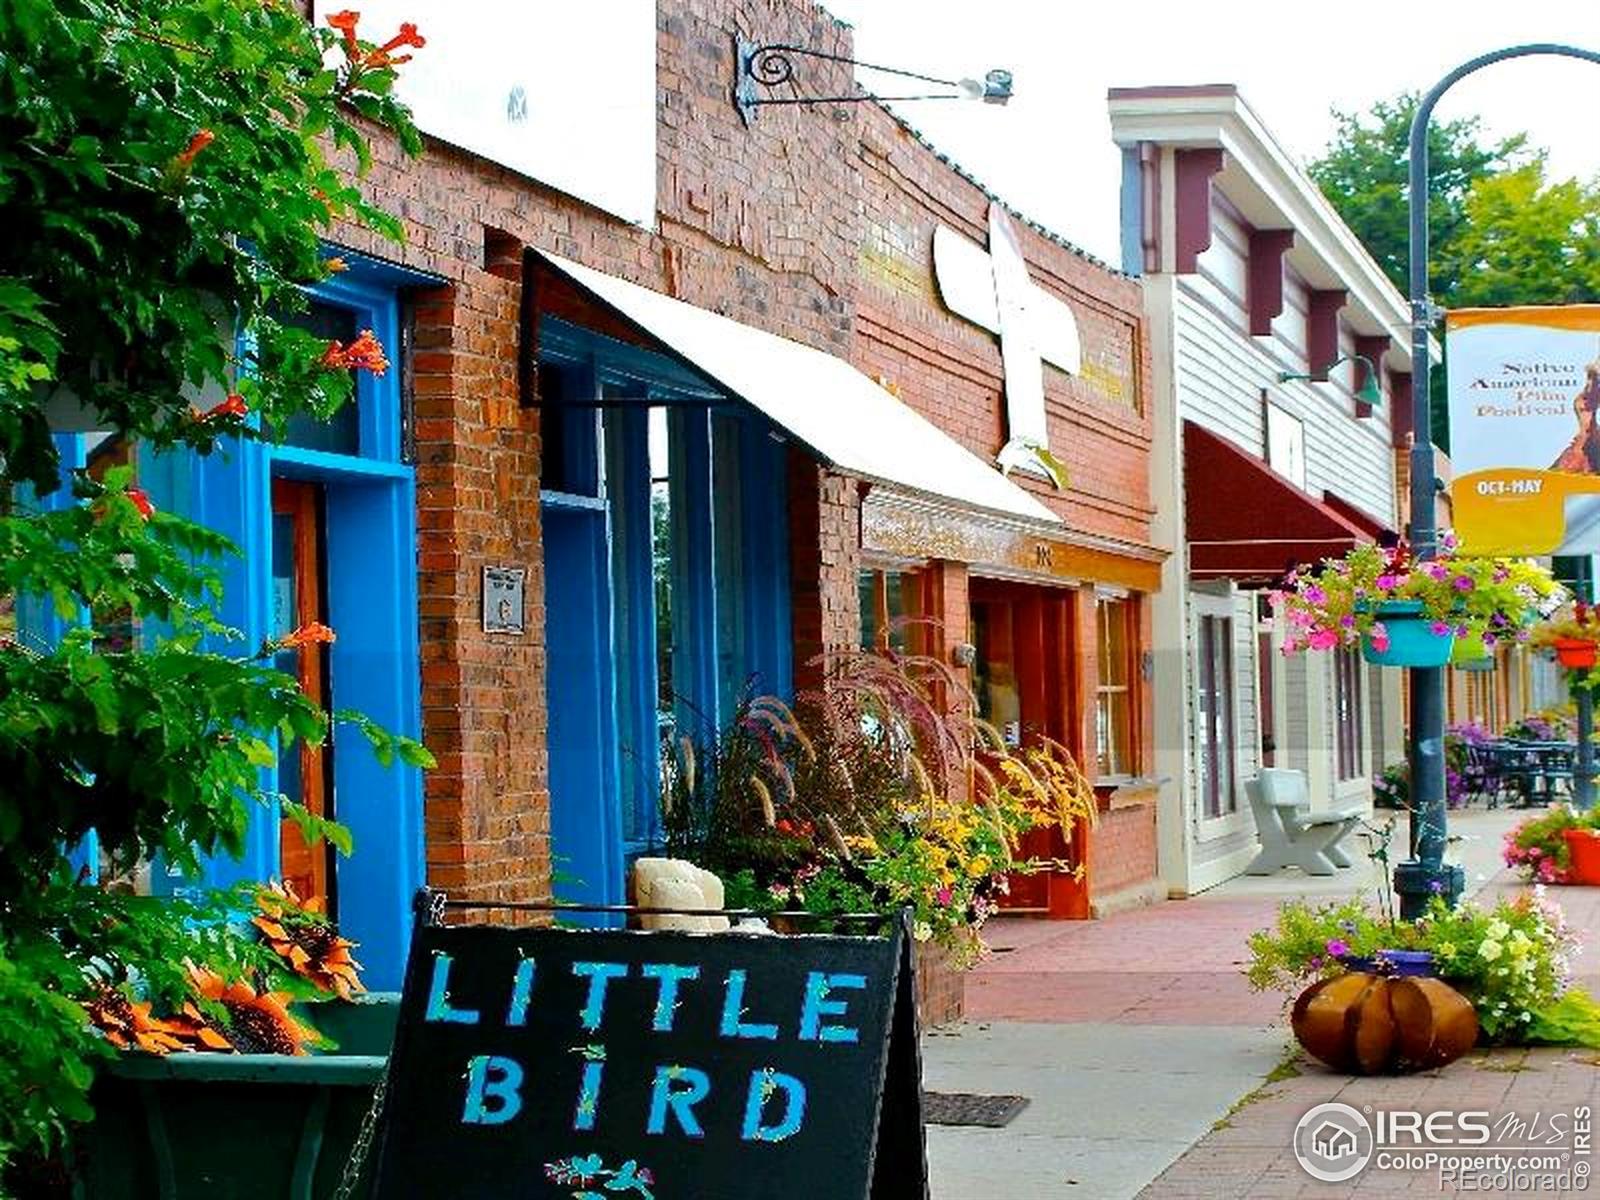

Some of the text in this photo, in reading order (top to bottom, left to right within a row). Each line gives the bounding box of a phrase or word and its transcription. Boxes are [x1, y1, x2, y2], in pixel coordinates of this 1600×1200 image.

[1503, 363, 1575, 375] Native
[1469, 377, 1578, 389] American
[1477, 404, 1567, 417] Festival
[1477, 479, 1543, 496] OCT-MAY
[424, 951, 868, 1043] LITTLE
[461, 1047, 808, 1142] BIRD
